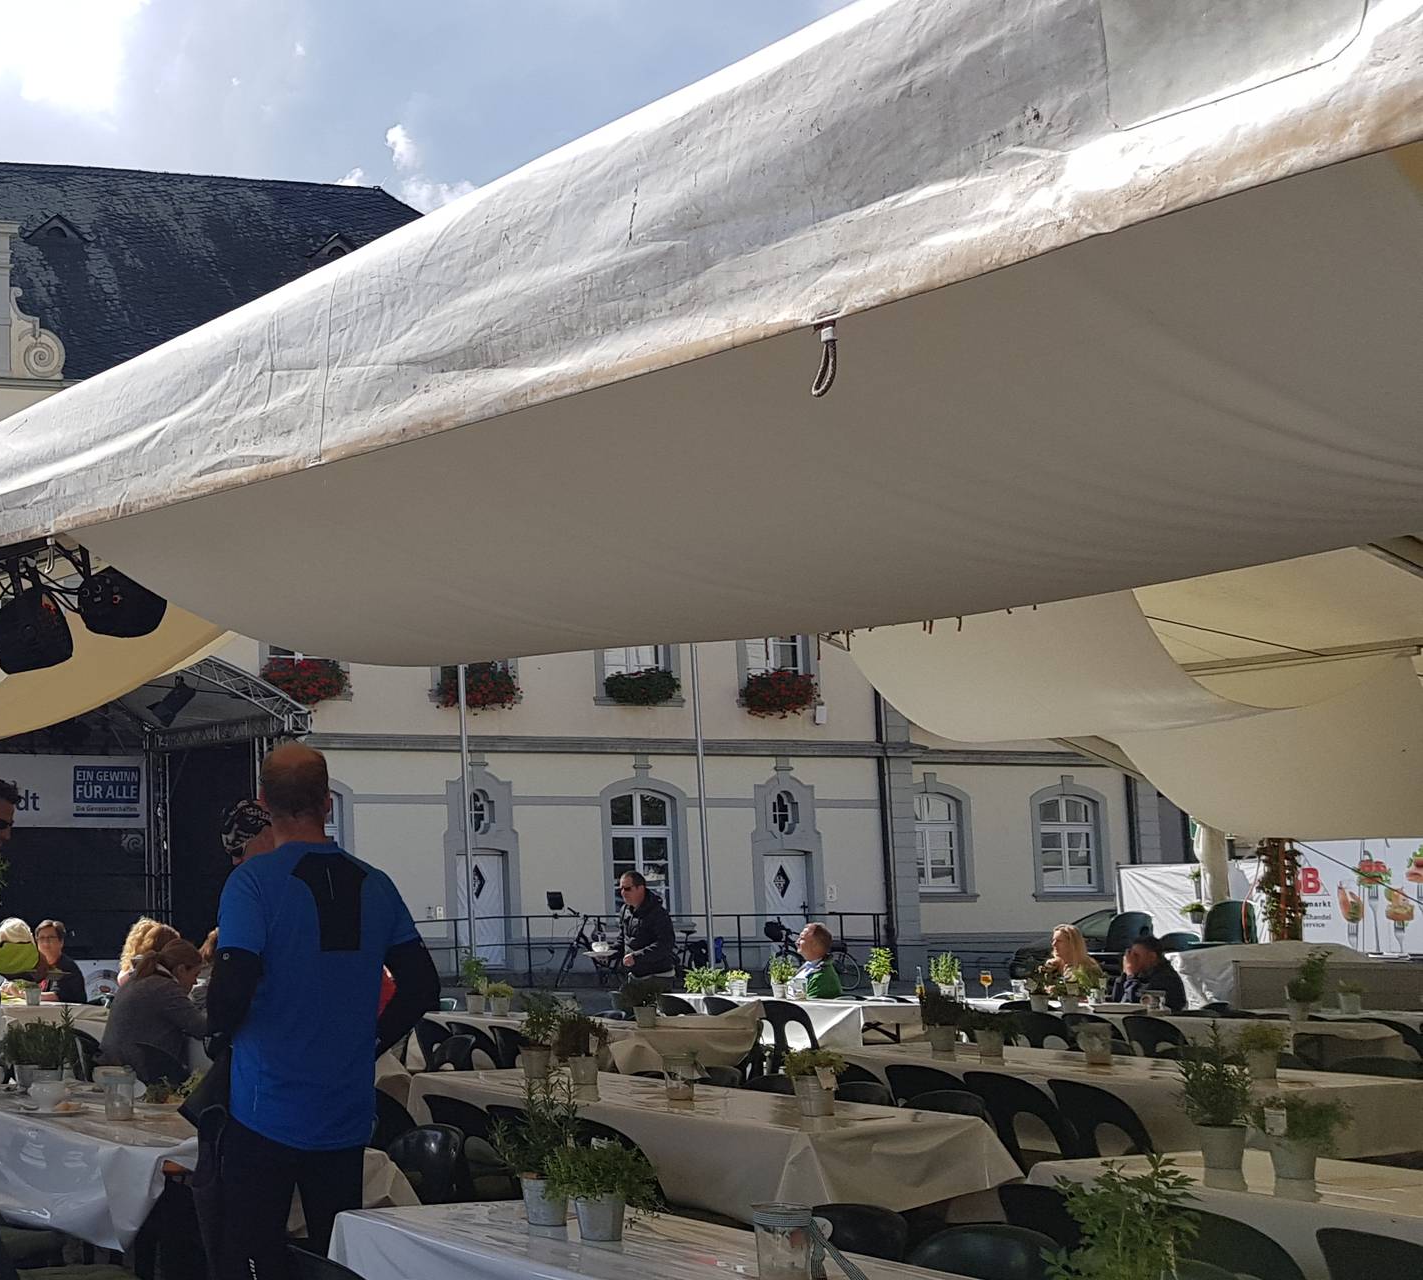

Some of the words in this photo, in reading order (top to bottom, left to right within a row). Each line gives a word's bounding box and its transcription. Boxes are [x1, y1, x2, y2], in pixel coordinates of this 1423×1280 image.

[76, 770, 94, 781] EIN
[96, 770, 138, 782] GEWINN
[75, 781, 103, 799] FÜR
[105, 785, 138, 799] ALLE
